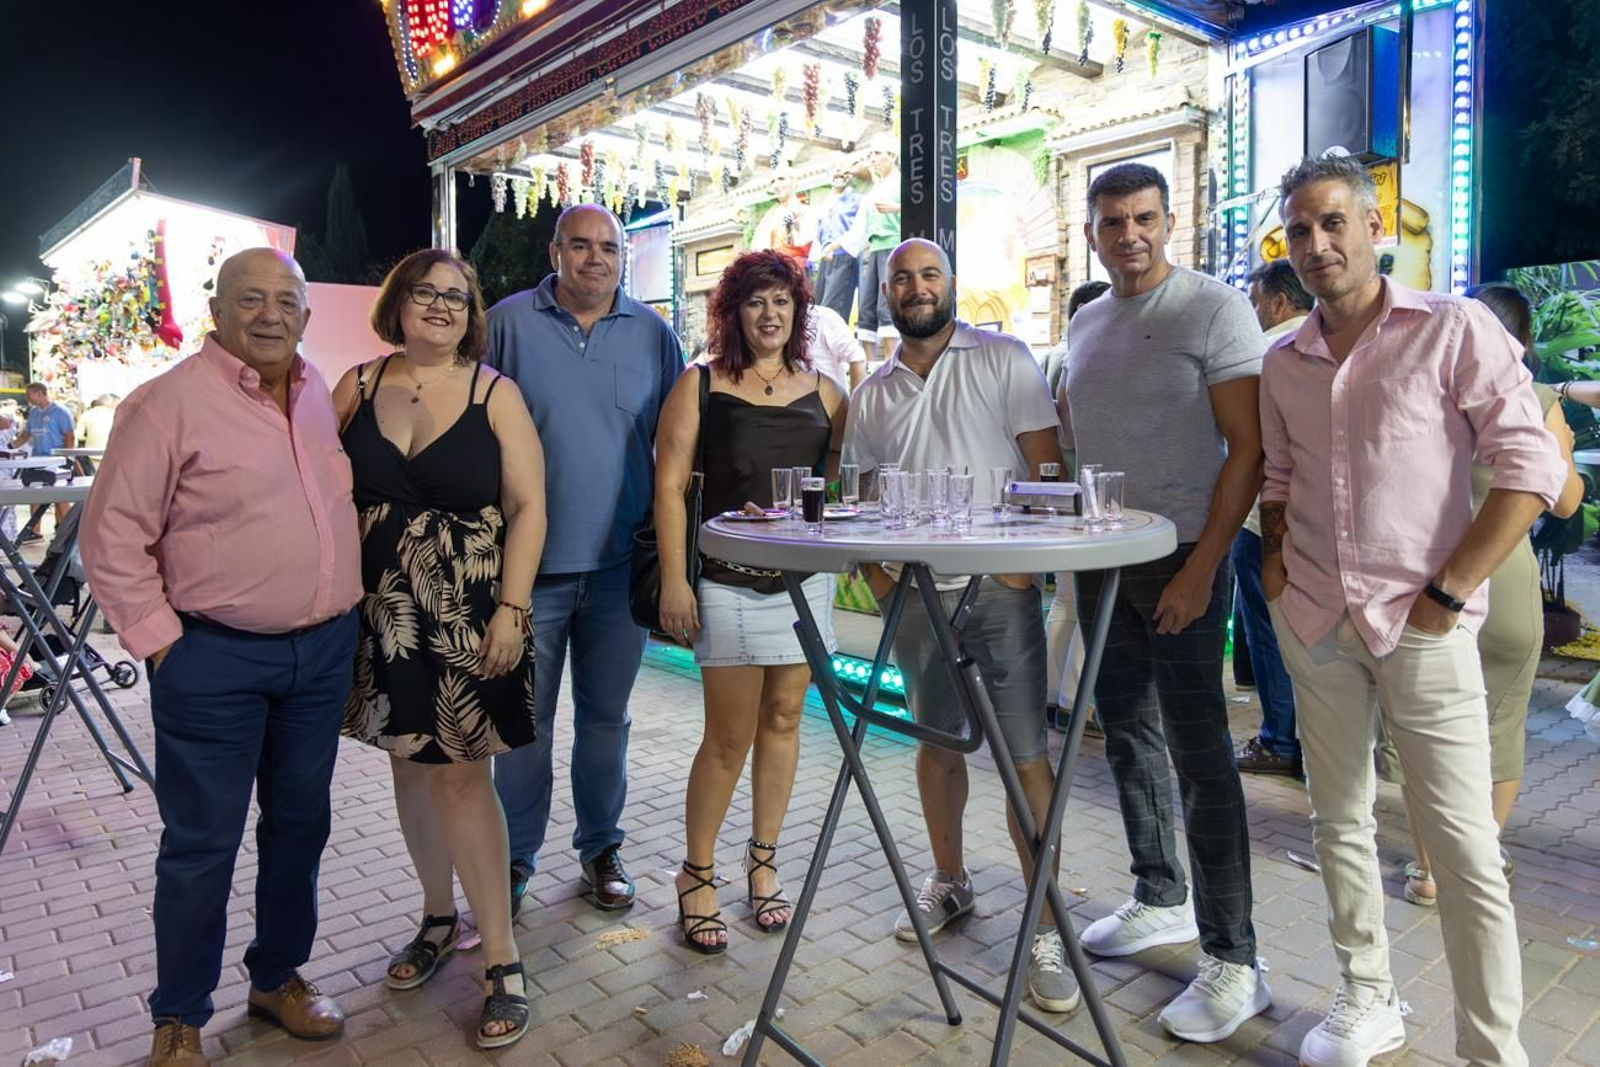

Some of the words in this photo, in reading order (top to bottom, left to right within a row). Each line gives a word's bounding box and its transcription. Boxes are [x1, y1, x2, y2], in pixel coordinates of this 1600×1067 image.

[909, 13, 926, 84] LOS
[939, 7, 955, 82] LOS
[909, 107, 925, 205] TRES
[939, 104, 954, 204] TRES
